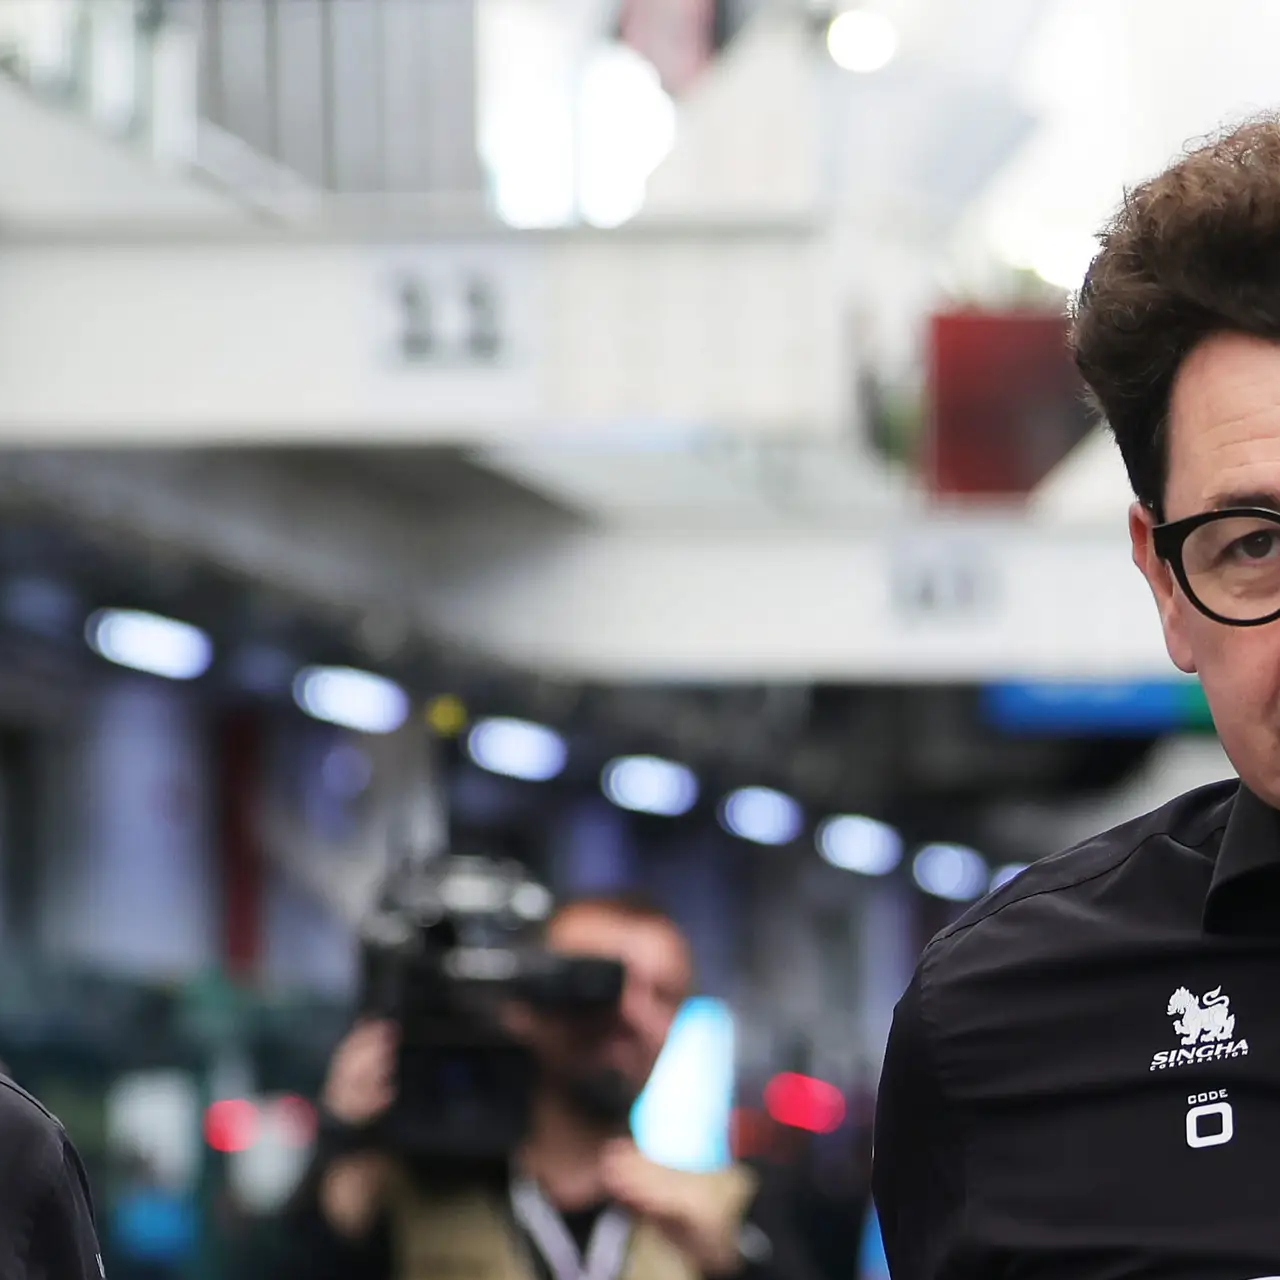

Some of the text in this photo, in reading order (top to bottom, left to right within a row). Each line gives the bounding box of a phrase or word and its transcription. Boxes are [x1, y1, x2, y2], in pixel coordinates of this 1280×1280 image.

[1150, 1050, 1248, 1071] CORPORATION
[1151, 1039, 1248, 1066] SINGHA
[1188, 1089, 1228, 1105] CODE
